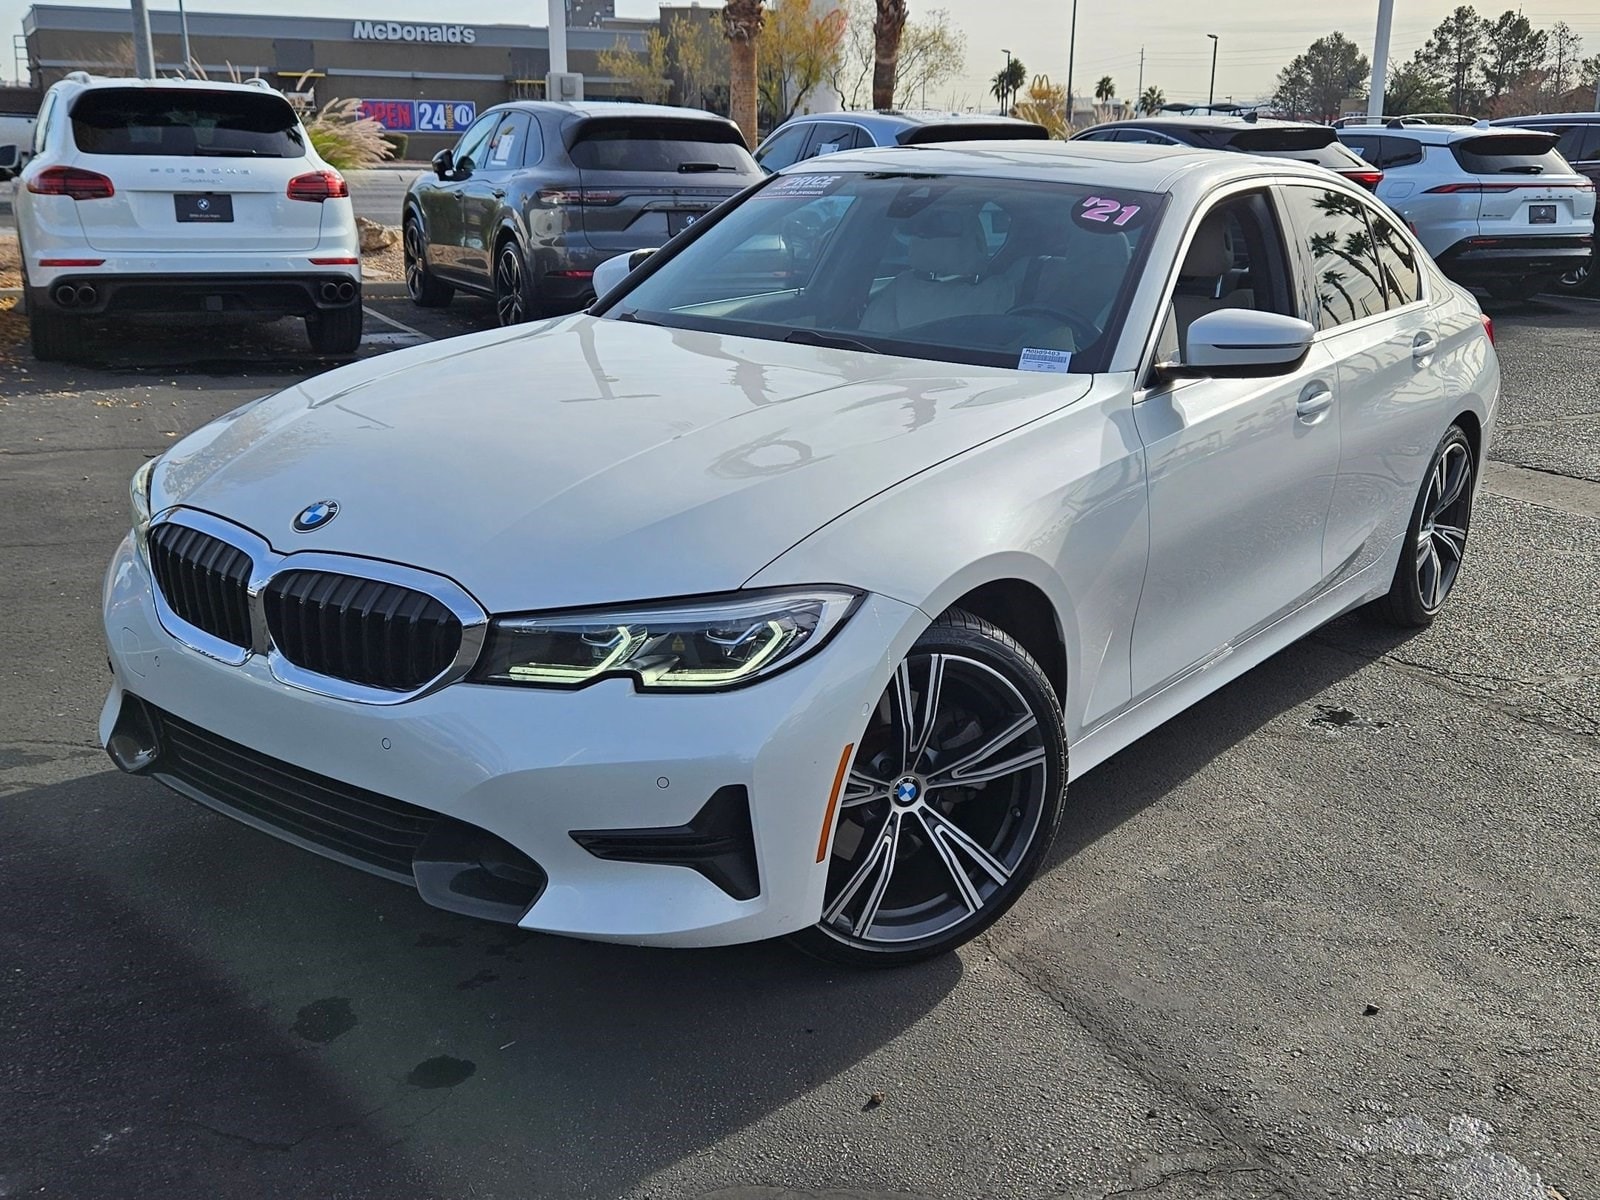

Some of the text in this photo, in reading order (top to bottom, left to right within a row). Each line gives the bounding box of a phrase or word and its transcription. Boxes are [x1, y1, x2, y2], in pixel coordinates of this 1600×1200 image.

[353, 21, 476, 43] McDonald's
[419, 103, 446, 130] 24
[784, 175, 842, 186] PRICE
[1081, 196, 1141, 226] '21
